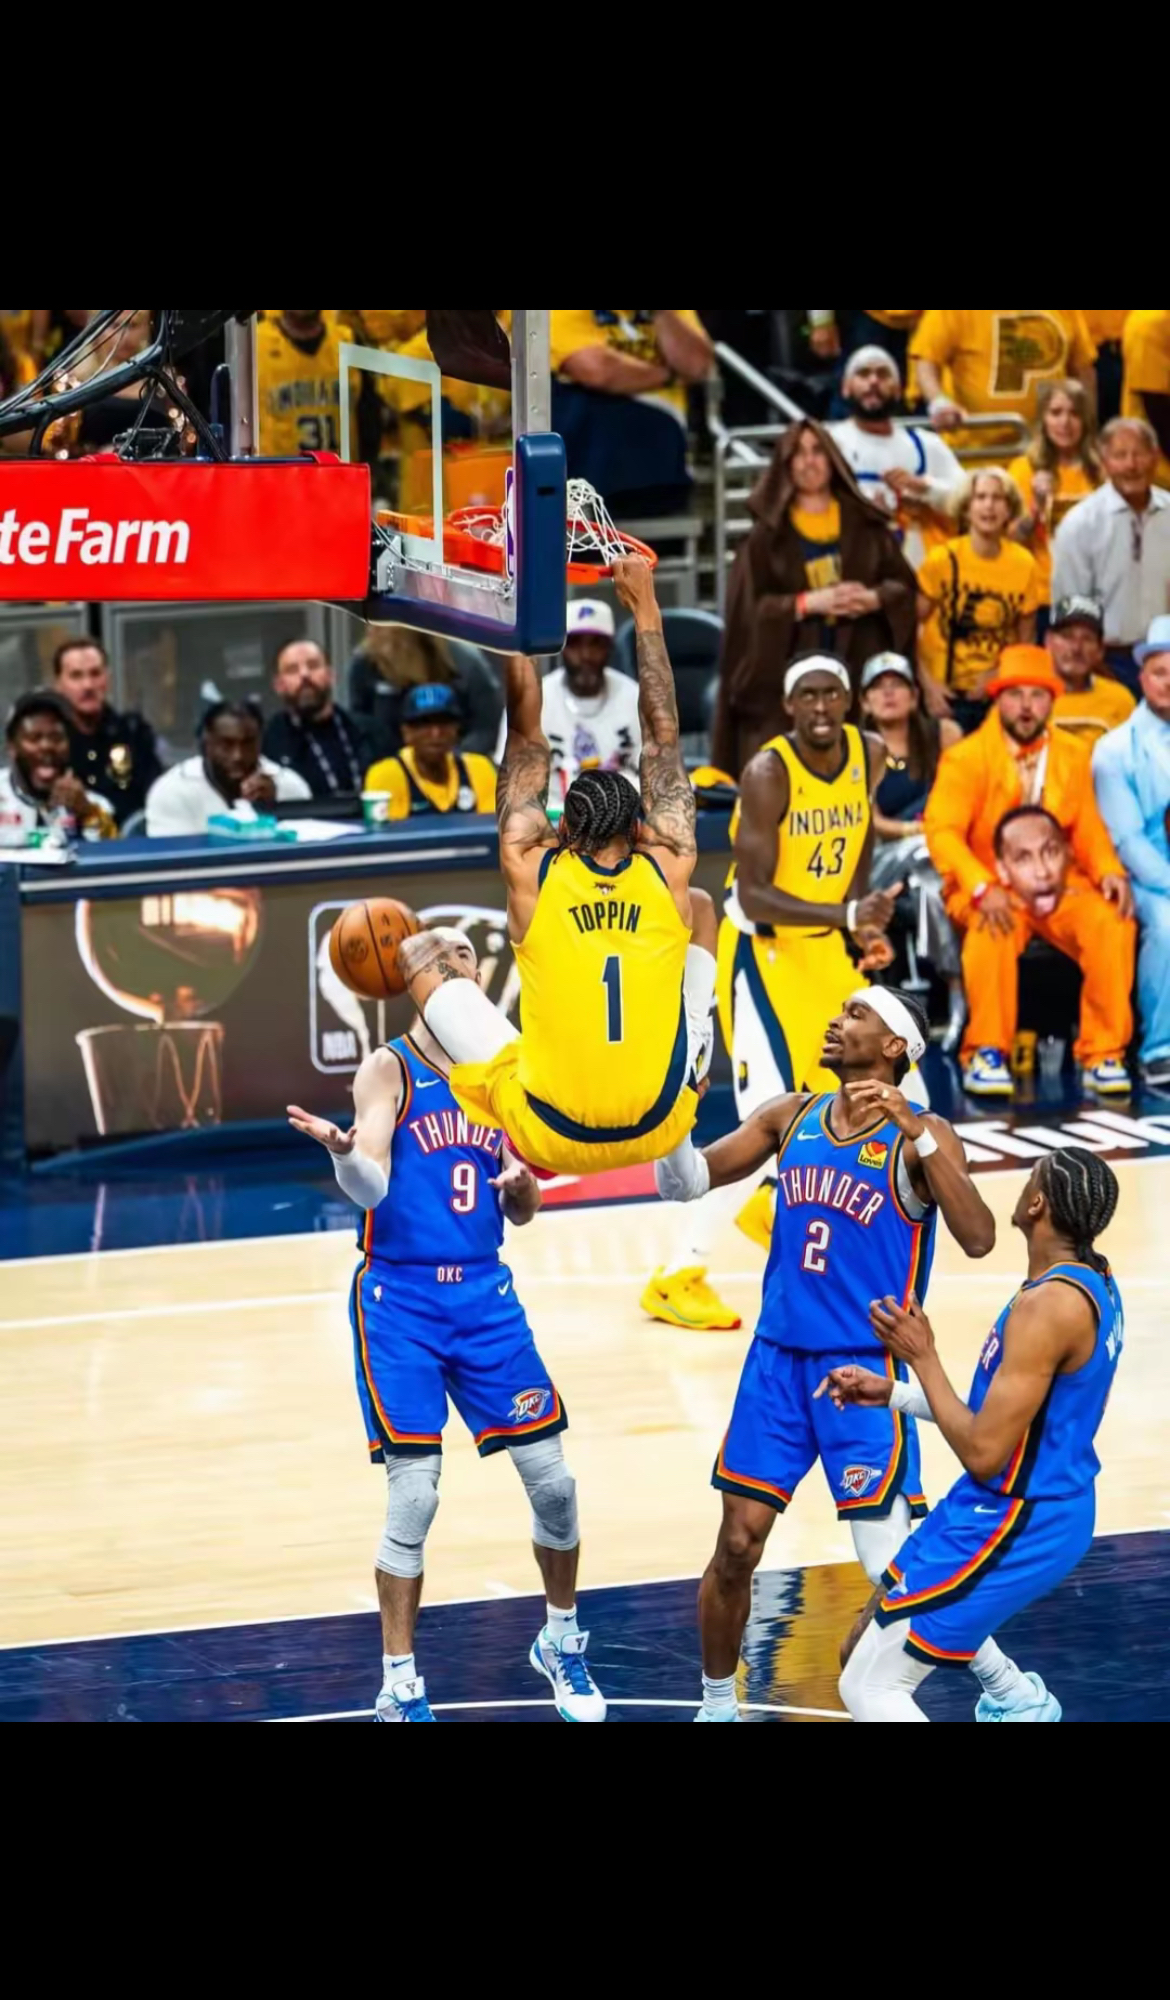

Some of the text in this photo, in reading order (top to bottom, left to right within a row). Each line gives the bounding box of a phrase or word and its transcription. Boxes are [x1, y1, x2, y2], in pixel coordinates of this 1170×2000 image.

[789, 801, 863, 837] INDIANA
[806, 837, 847, 879] 43
[568, 900, 642, 934] TOPPIN
[601, 955, 623, 1043] 1
[408, 1109, 503, 1159] THUNDE
[451, 1162, 478, 1215] 9
[779, 1166, 885, 1226] THUNDER
[802, 1218, 832, 1274] 2
[436, 1266, 464, 1283] OKC
